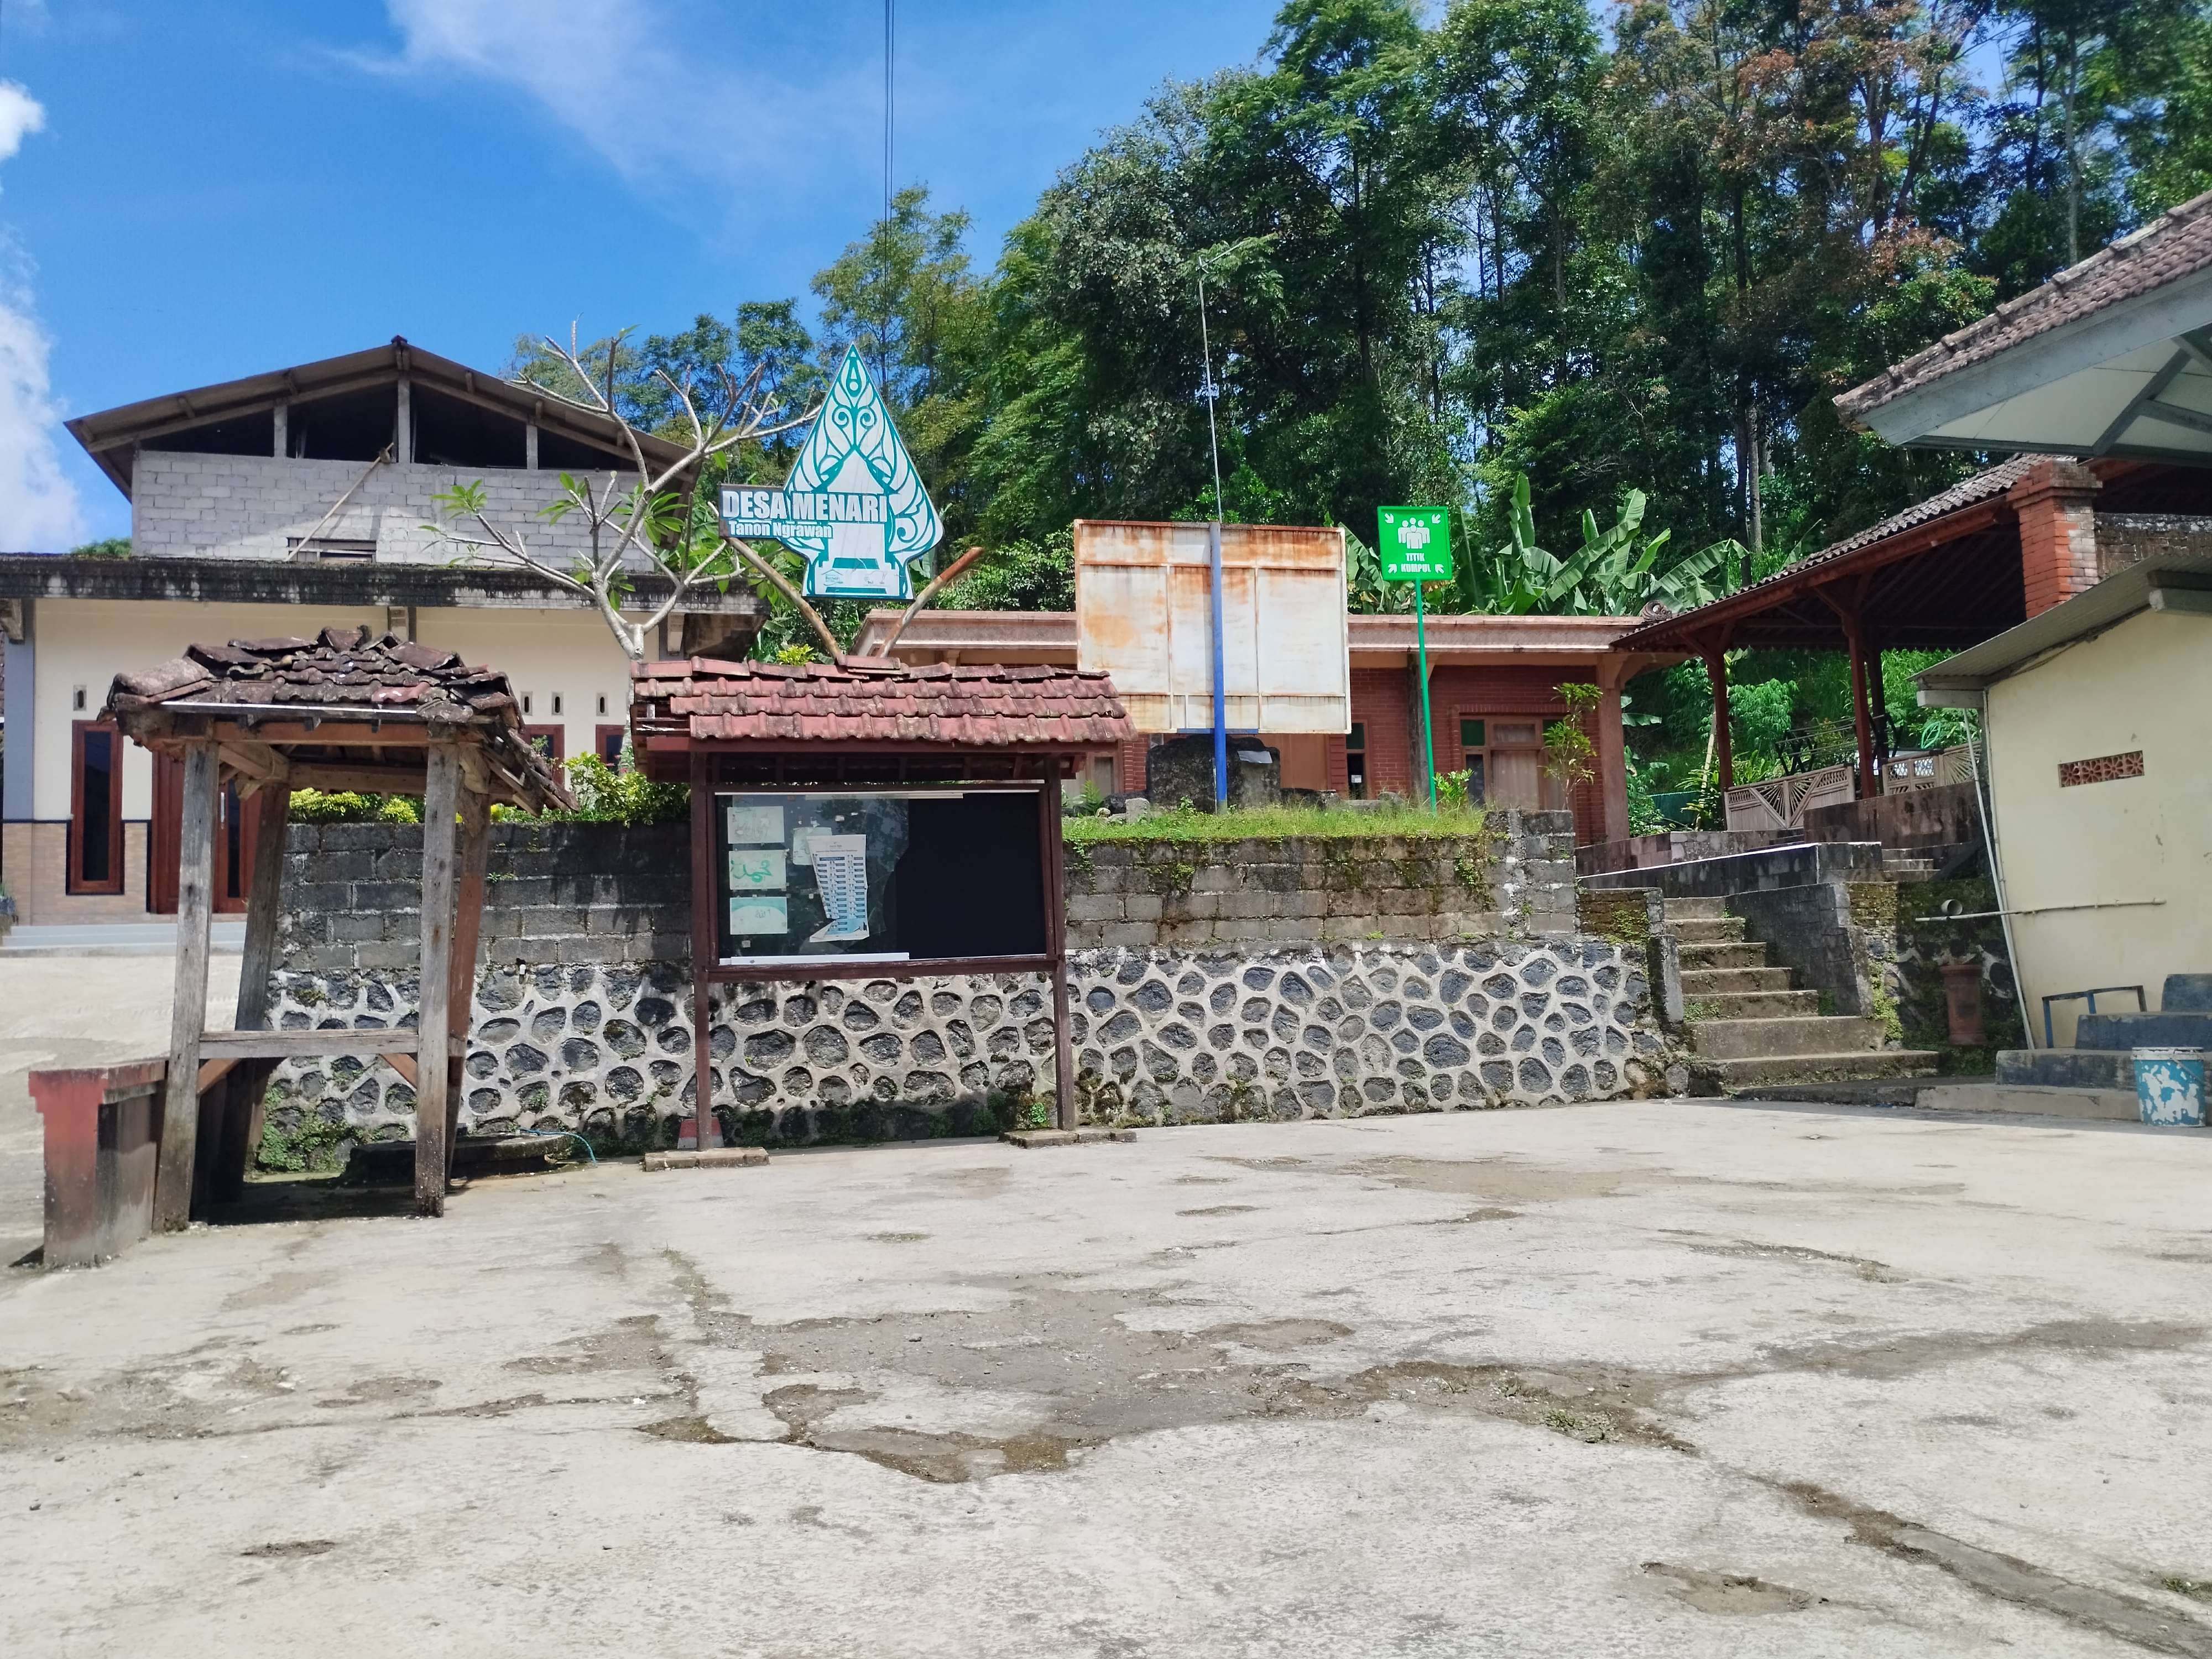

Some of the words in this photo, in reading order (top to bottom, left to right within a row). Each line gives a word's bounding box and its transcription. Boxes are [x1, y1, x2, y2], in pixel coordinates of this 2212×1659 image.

[722, 491, 787, 519] DESA
[792, 492, 888, 523] MENARI
[729, 520, 770, 536] Tanon
[773, 521, 832, 538] Ngrawan
[1405, 552, 1425, 562] TITIK
[1401, 564, 1431, 573] KUMPUL
